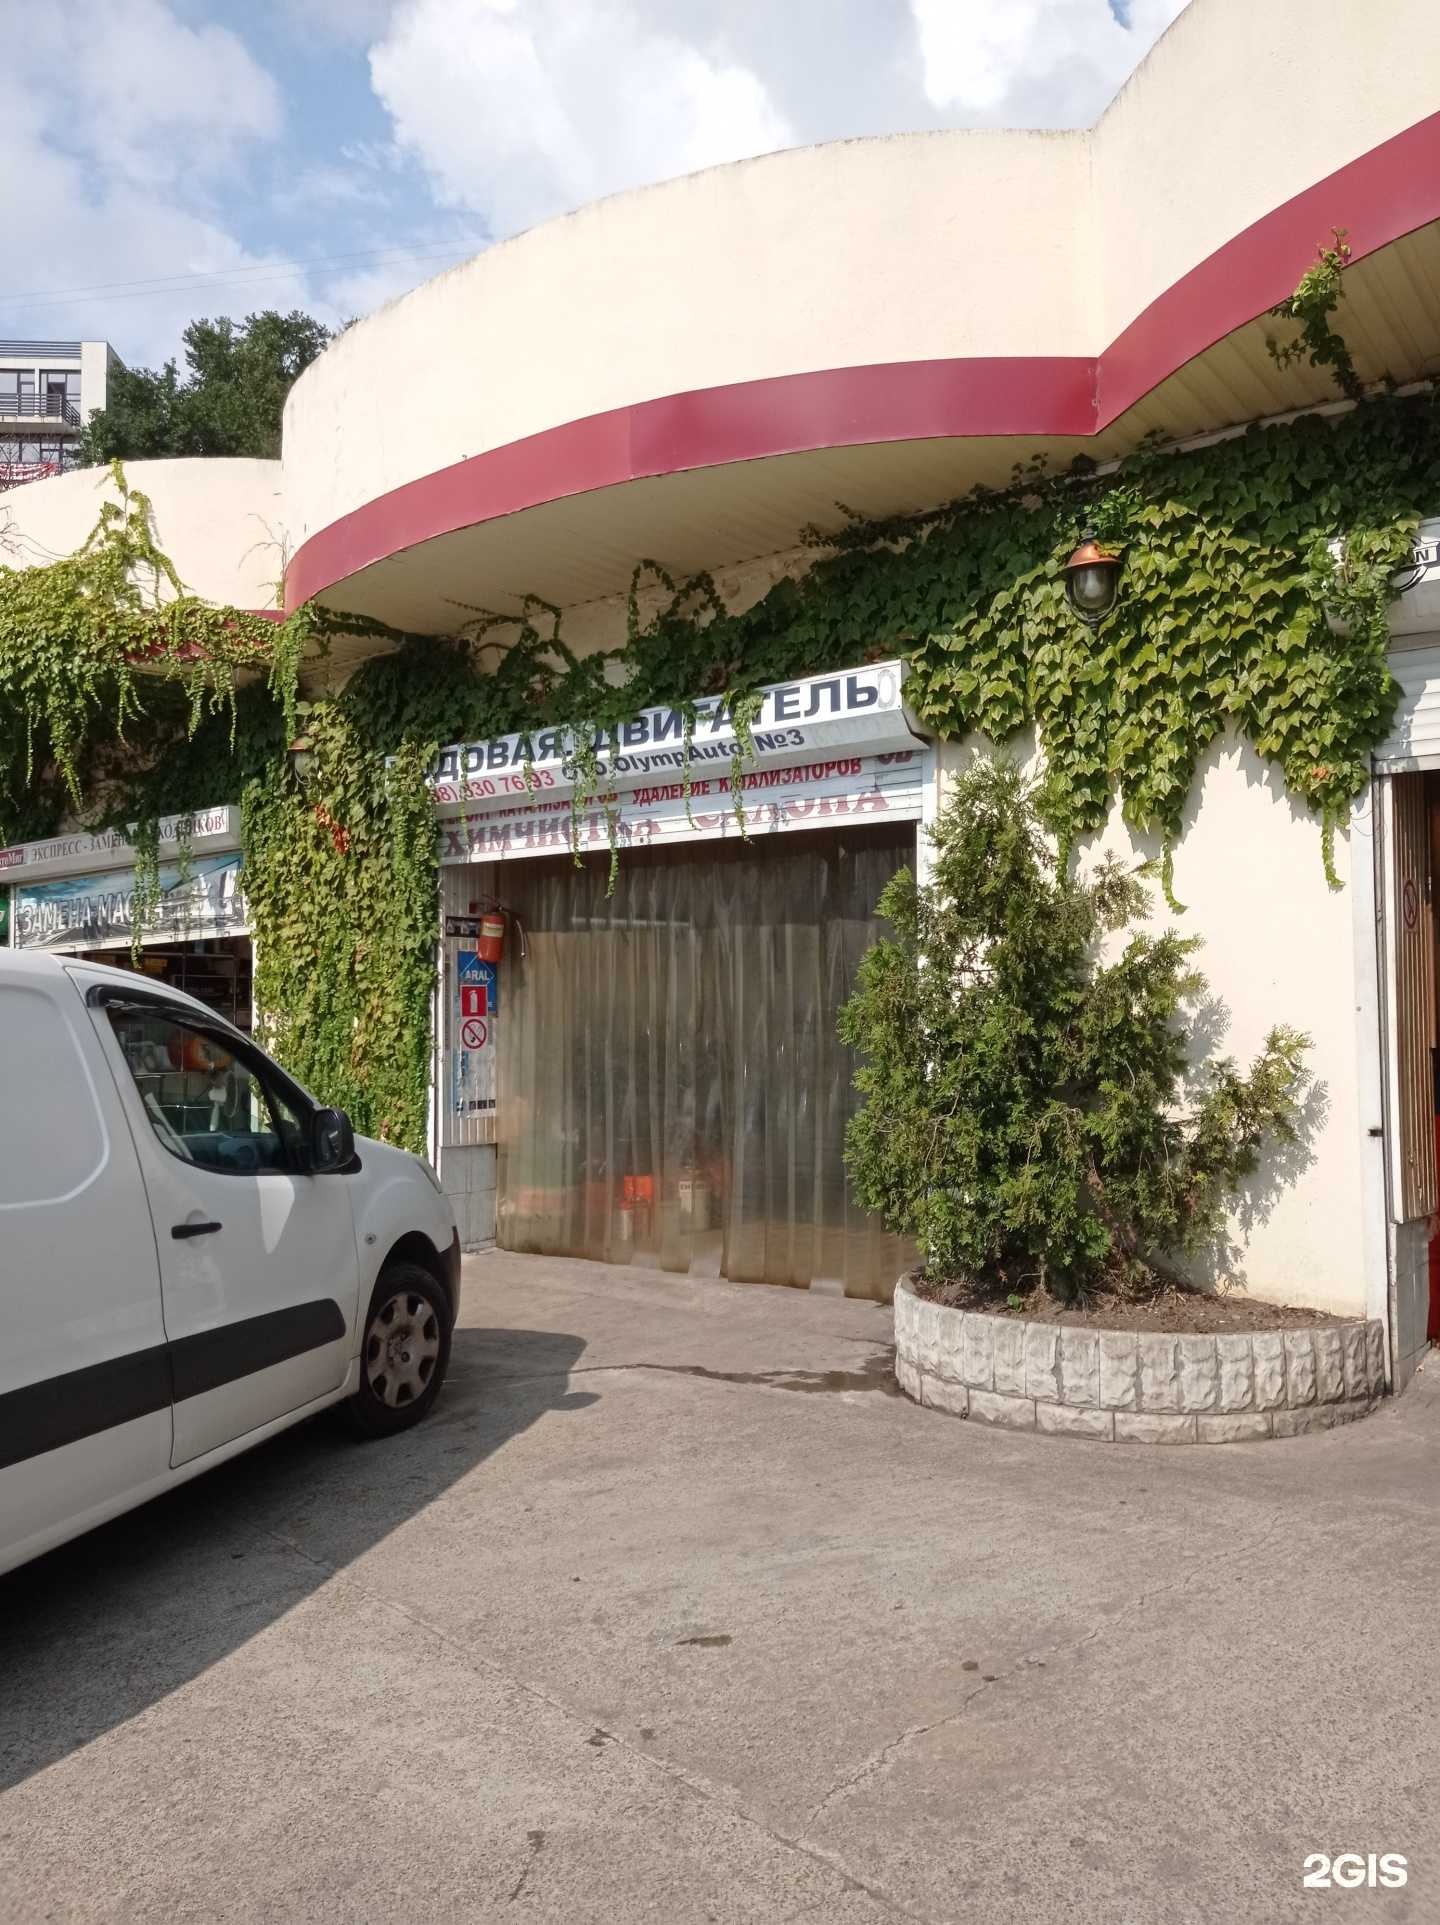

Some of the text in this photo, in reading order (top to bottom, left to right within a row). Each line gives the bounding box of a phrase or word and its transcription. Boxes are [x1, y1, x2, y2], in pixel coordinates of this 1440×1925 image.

[614, 739, 745, 773] OlympAuto
[754, 728, 805, 752] №3
[498, 775, 525, 793] 76
[529, 769, 556, 789] 93
[632, 779, 711, 807] УДАЛЕНИЕ
[718, 757, 863, 793] КТАЛИЗАТОРОВ
[22, 896, 93, 934] ЗАМЕНА
